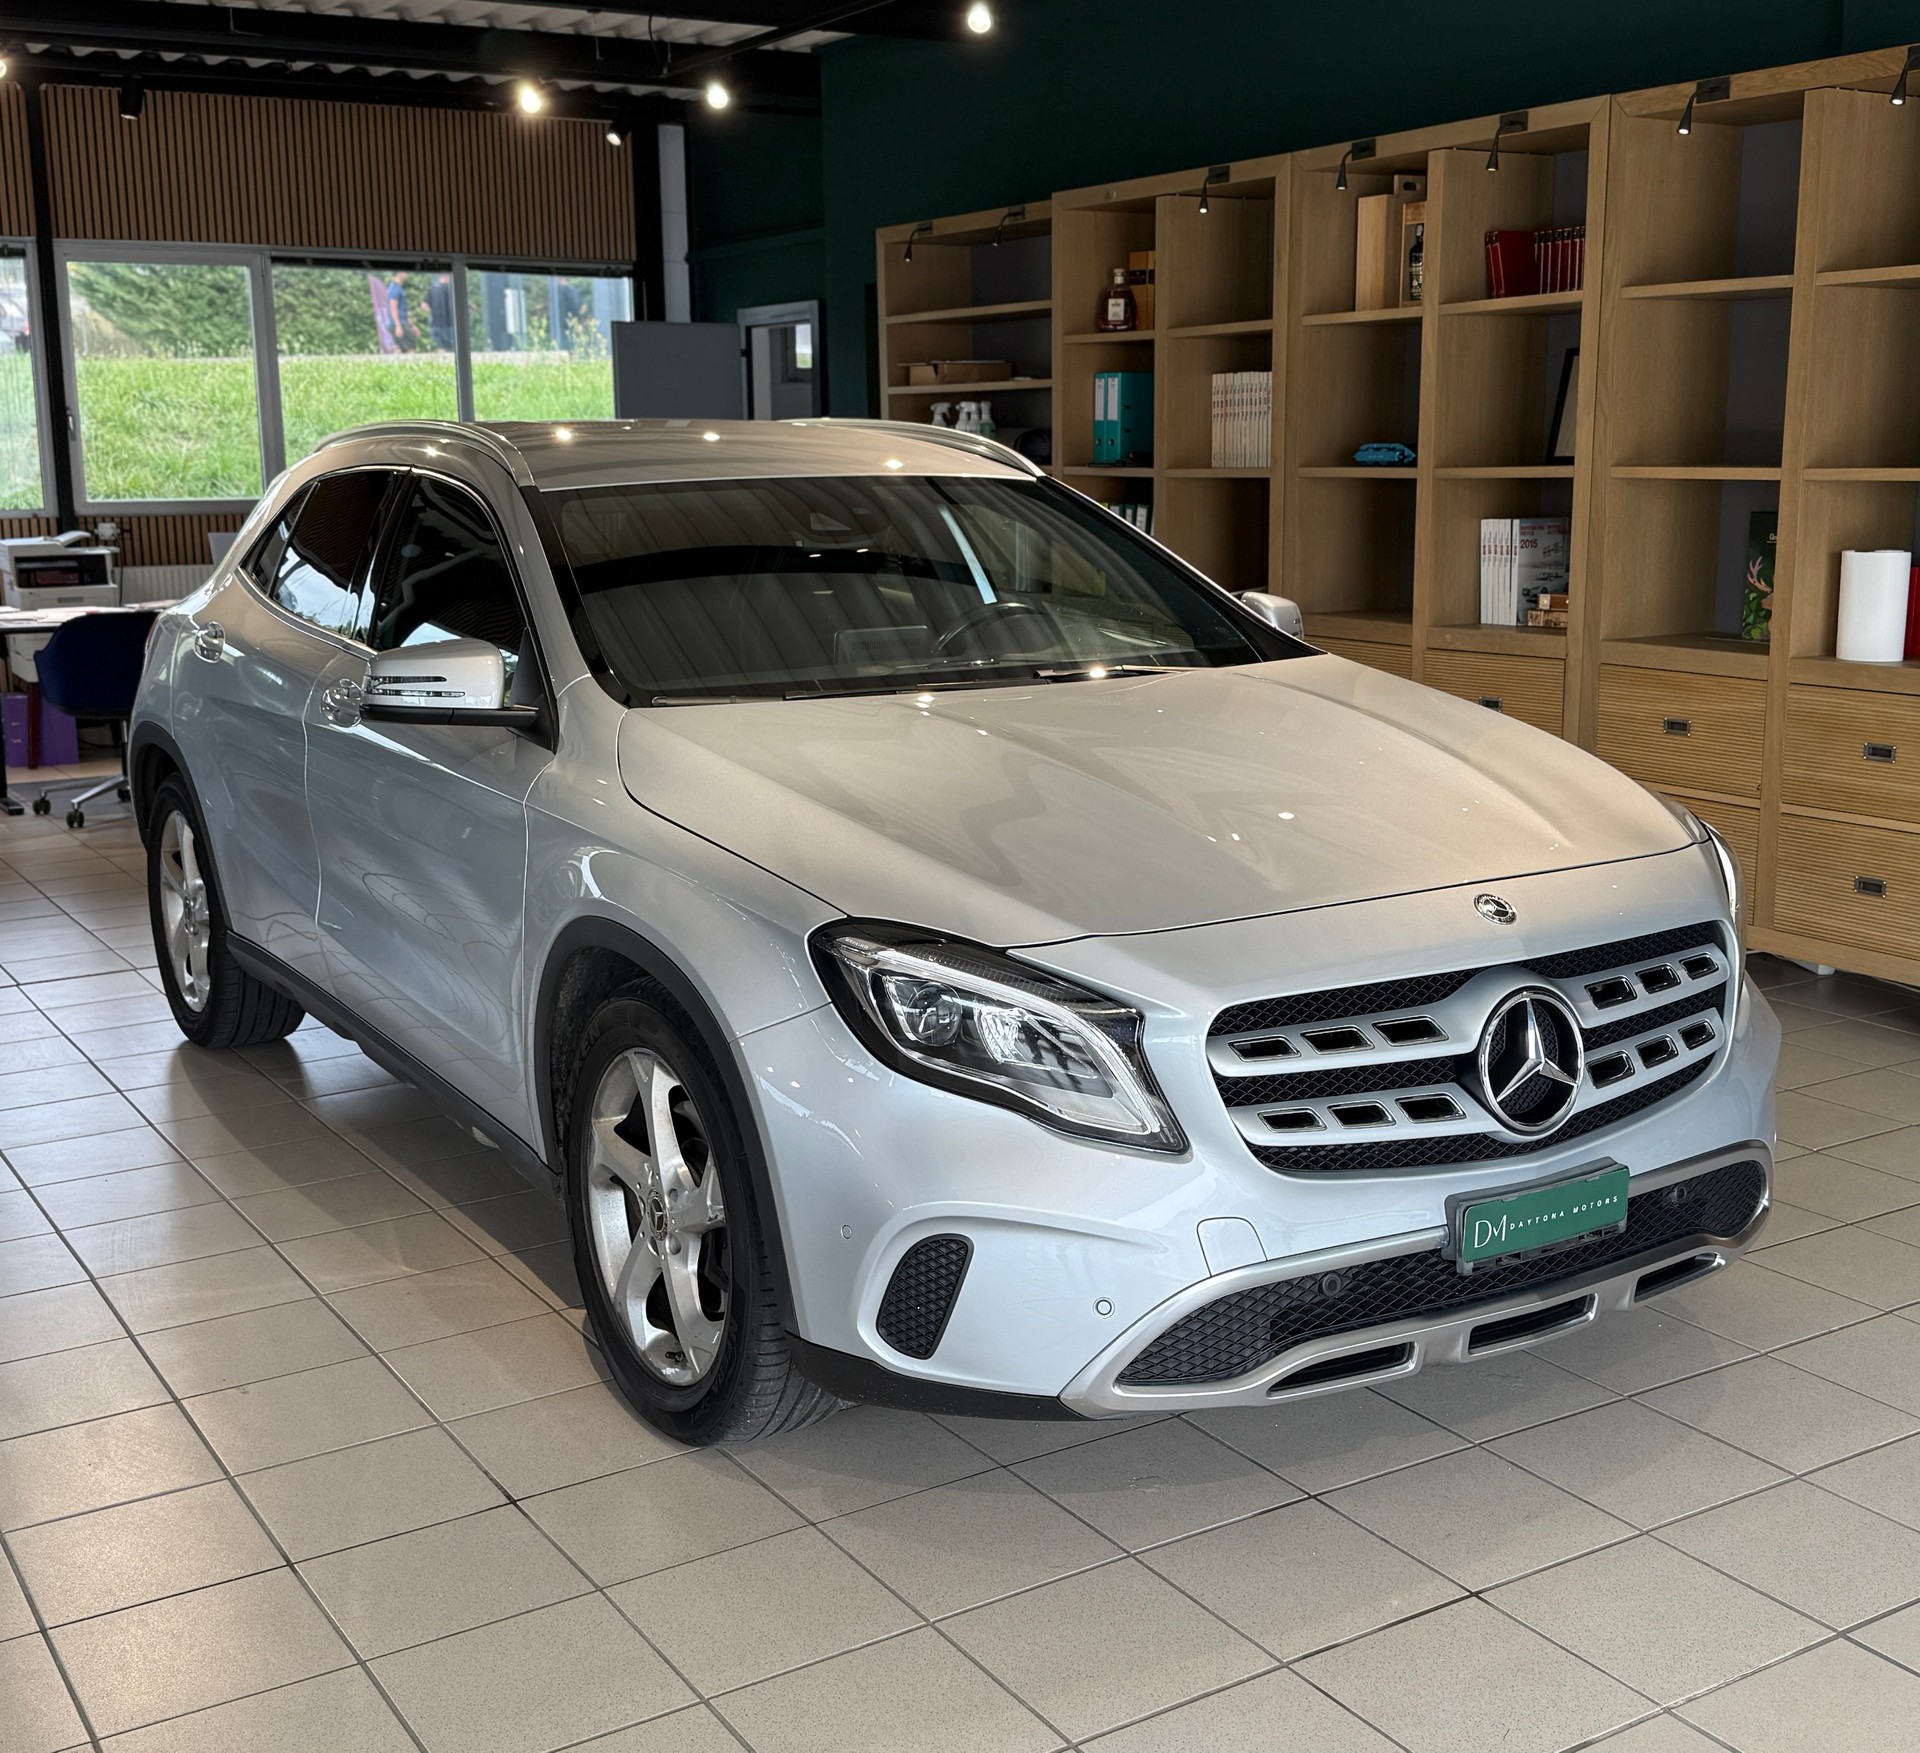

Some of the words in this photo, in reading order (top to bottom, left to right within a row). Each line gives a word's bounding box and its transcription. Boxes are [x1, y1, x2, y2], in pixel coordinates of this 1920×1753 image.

[1520, 538, 1538, 549] 2015
[1509, 1210, 1565, 1230] DAYTONA
[1572, 1195, 1618, 1215] MOTORS
